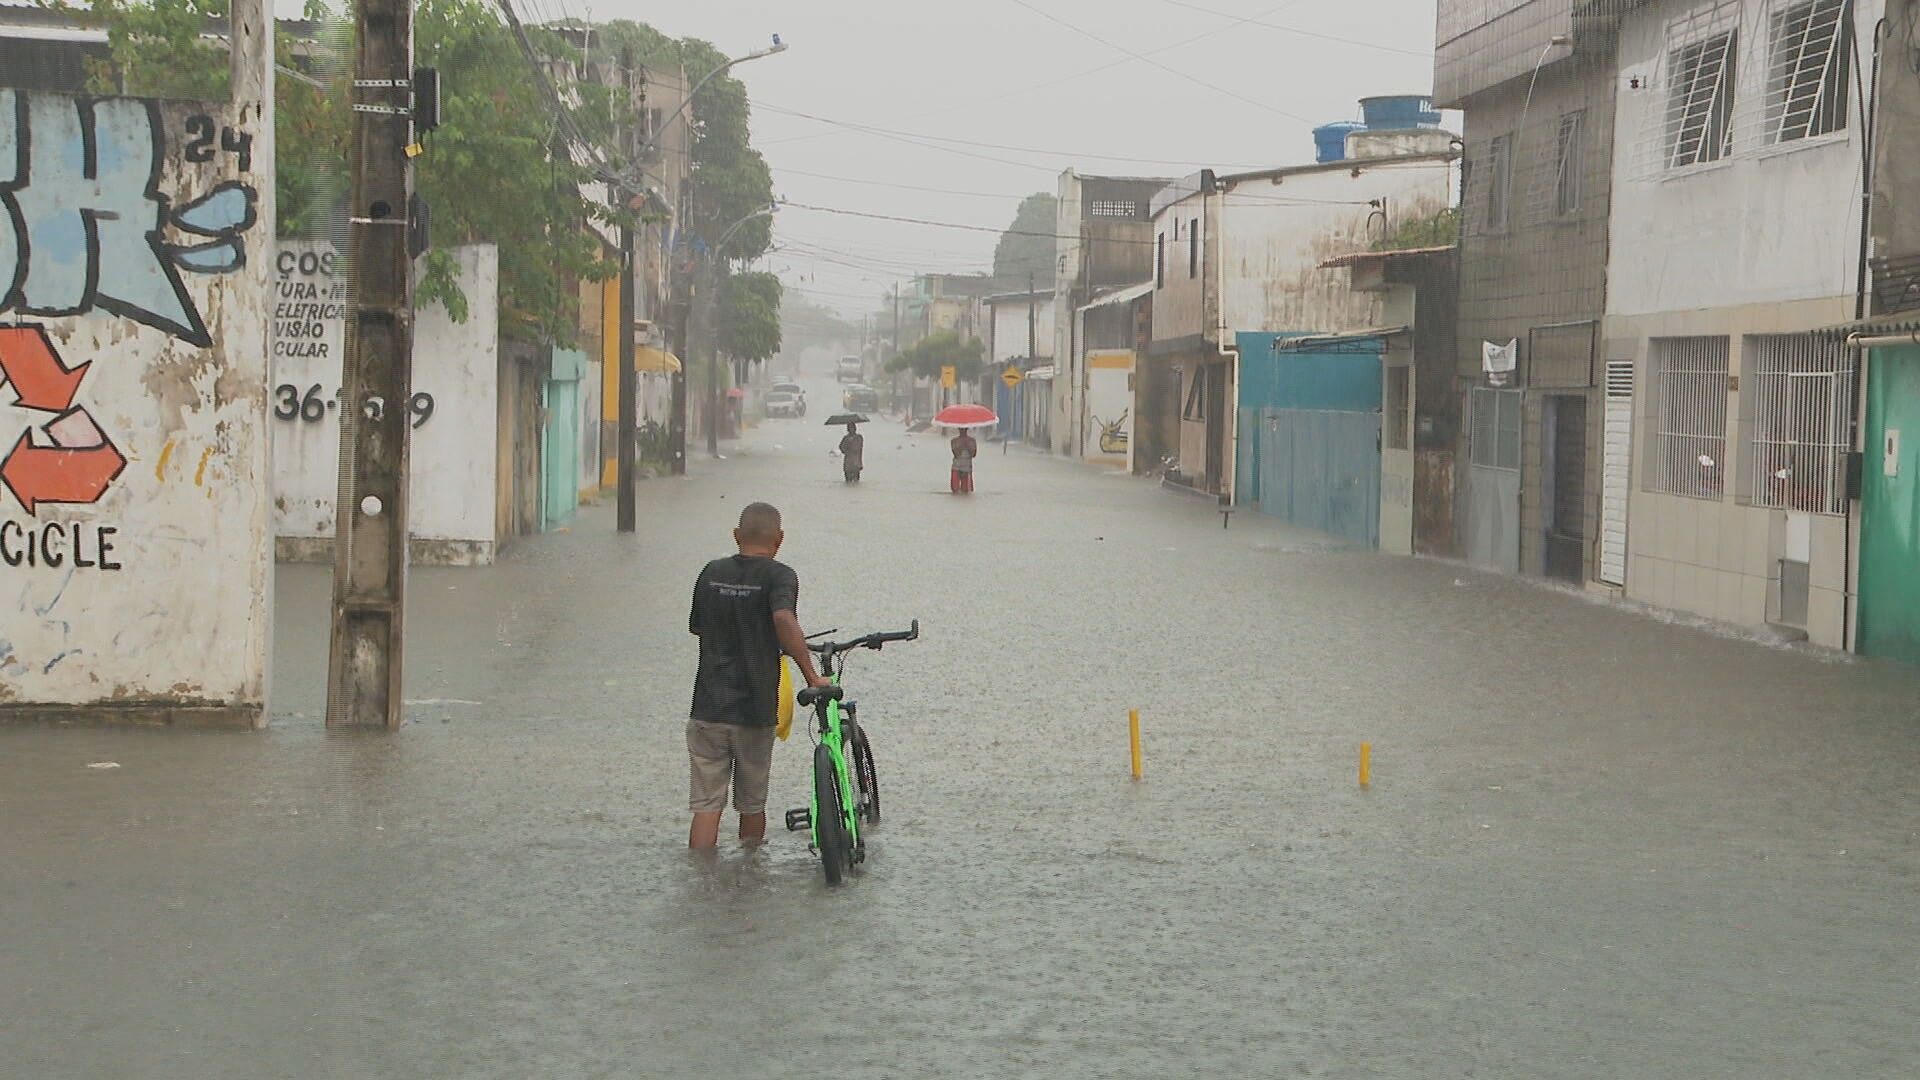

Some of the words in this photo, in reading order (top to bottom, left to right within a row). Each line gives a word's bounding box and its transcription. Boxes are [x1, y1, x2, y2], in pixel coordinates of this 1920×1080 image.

[185, 114, 252, 172] 24
[274, 341, 328, 358] CULAR
[1, 519, 122, 570] CICLE
